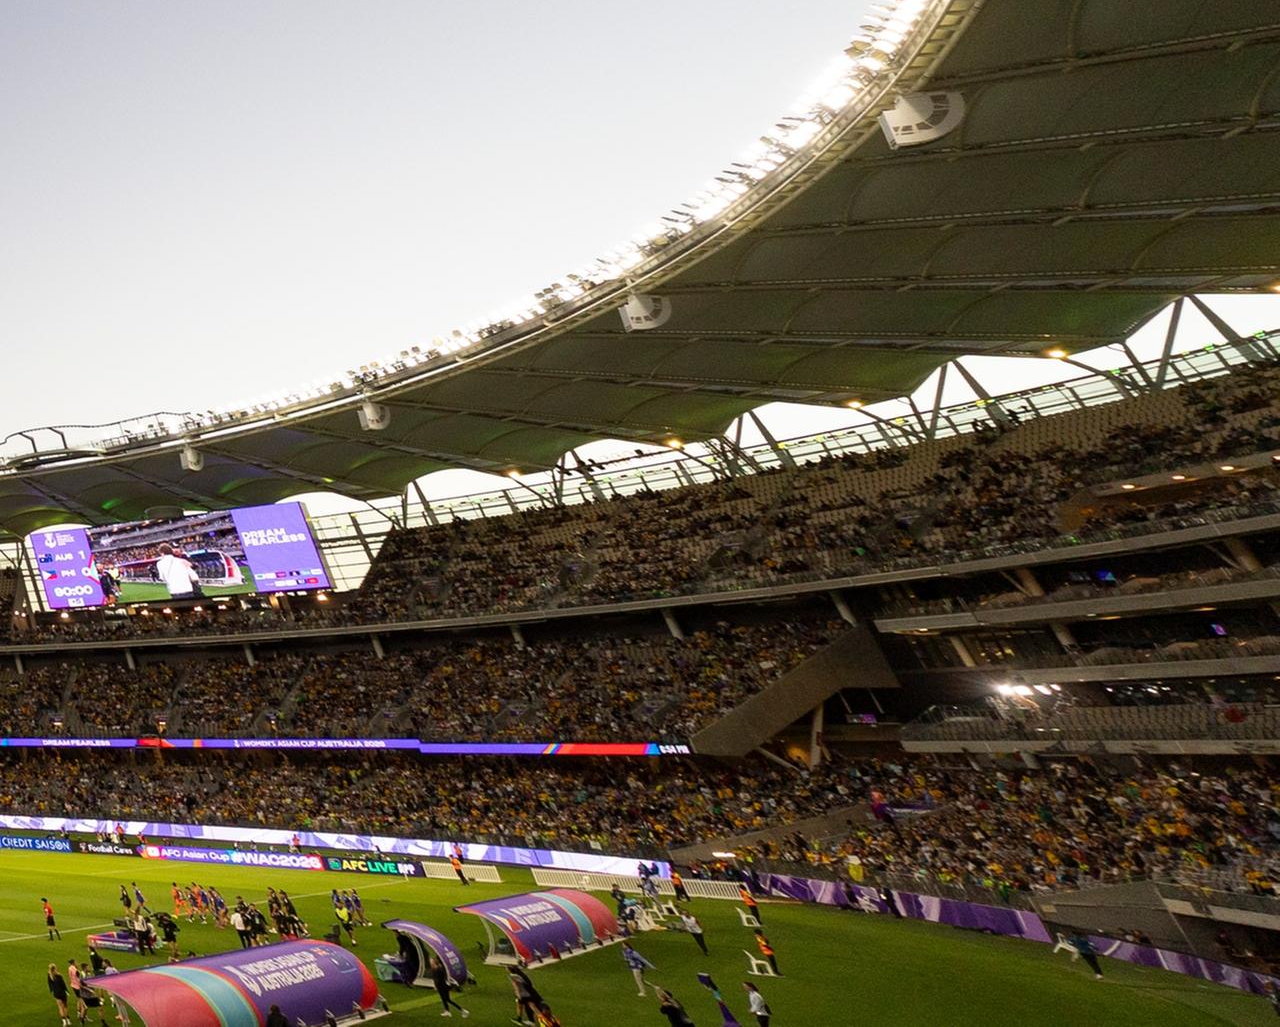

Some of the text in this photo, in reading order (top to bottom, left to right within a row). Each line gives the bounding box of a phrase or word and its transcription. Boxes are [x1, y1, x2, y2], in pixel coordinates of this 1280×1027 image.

[241, 527, 286, 541] DREAM
[244, 533, 307, 547] FEARLESS
[55, 550, 86, 562] AUS 1
[317, 740, 363, 748] AUSTRALIA
[2, 837, 70, 850] CREDIT SAISON
[88, 844, 113, 853] Football
[161, 849, 322, 869] AFC Asian Cup #WAC2026
[342, 859, 368, 871] AFC
[257, 966, 306, 991] AUSTRALIA
